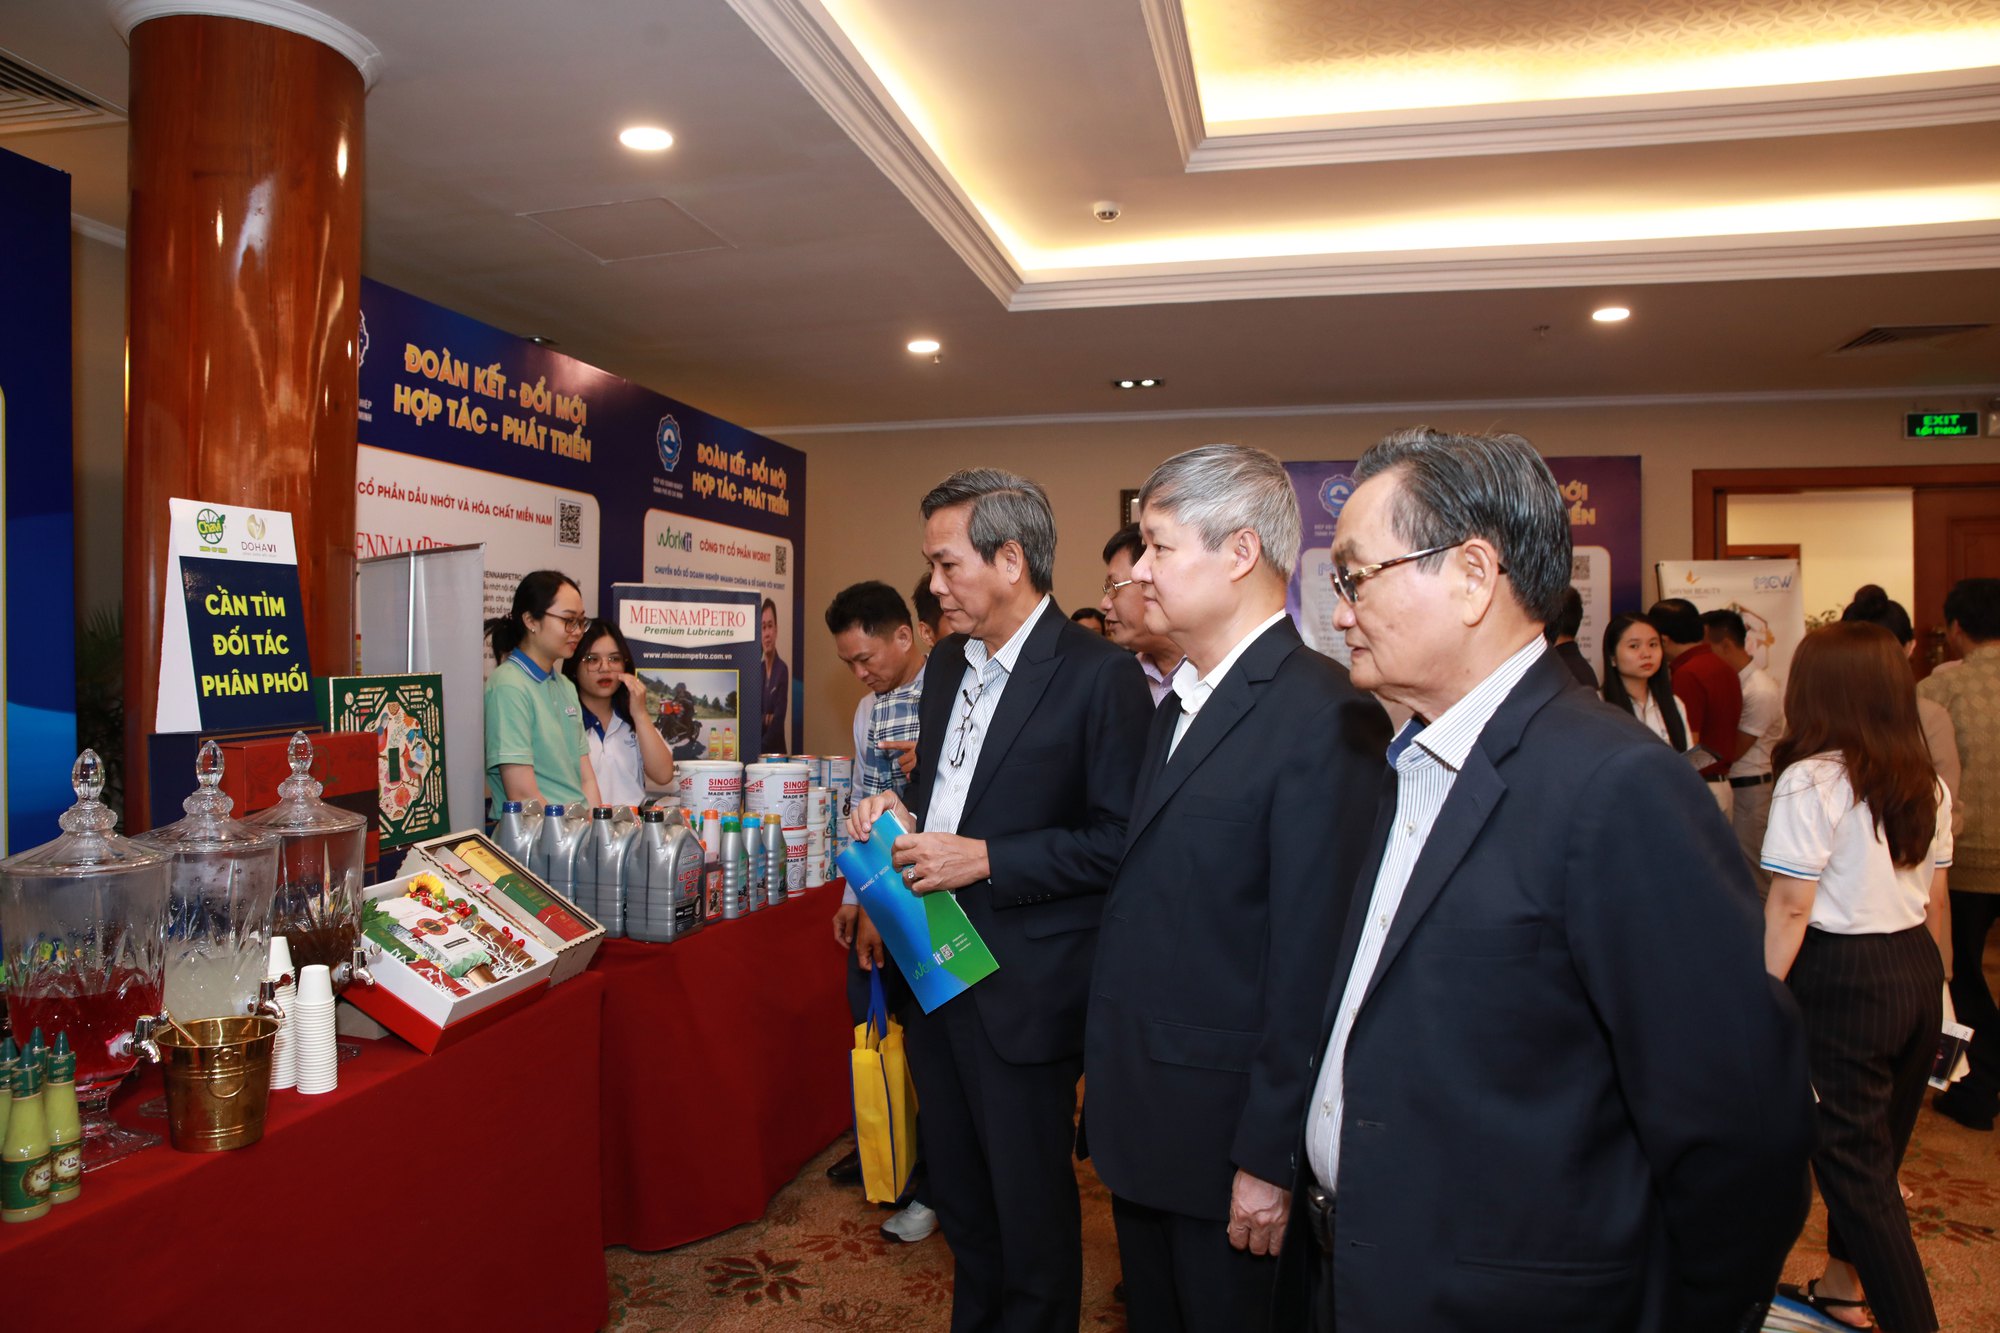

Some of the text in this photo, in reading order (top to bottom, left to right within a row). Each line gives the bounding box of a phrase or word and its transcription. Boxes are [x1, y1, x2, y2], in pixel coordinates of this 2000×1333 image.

[404, 343, 469, 389] ĐOÀN
[474, 363, 506, 400] KẾT
[520, 376, 552, 416] ĐỔI
[556, 394, 587, 427] MỚI
[394, 383, 442, 426] HỢP
[447, 396, 487, 435] TÁC
[502, 415, 547, 450] PHÁT
[550, 425, 592, 463] TRIỂN
[1923, 414, 1960, 425] EXIT
[697, 442, 728, 471] ĐOÀN
[730, 450, 746, 477] KẾT
[752, 456, 768, 484] ĐỔI
[770, 467, 787, 490] MỚI
[357, 477, 375, 495] CỔ
[430, 494, 455, 509] NHỚT
[458, 497, 469, 511] VÀ
[472, 500, 490, 515] HÓA
[493, 504, 514, 519] CHẤT
[516, 506, 534, 523] MIỀN
[536, 513, 552, 525] NAM
[692, 471, 715, 499] HỢP
[717, 475, 737, 502] TÁC
[743, 486, 766, 510] PHÁT
[768, 489, 789, 517] TRIỂN
[241, 541, 277, 553] DOHAVI
[700, 538, 718, 554] CÔNG
[719, 544, 725, 555] TY
[727, 541, 736, 557] CỔ
[205, 585, 286, 617] CẦN TÌM
[630, 605, 745, 627] MIENNAMPETRO
[213, 625, 289, 656] ĐỐI TÁC
[644, 626, 734, 637] Premium Lubricants
[643, 651, 732, 661] www.miennampetro.com.vn
[201, 663, 309, 697] PHÂN PHỐI
[860, 877, 875, 892] MAKING
